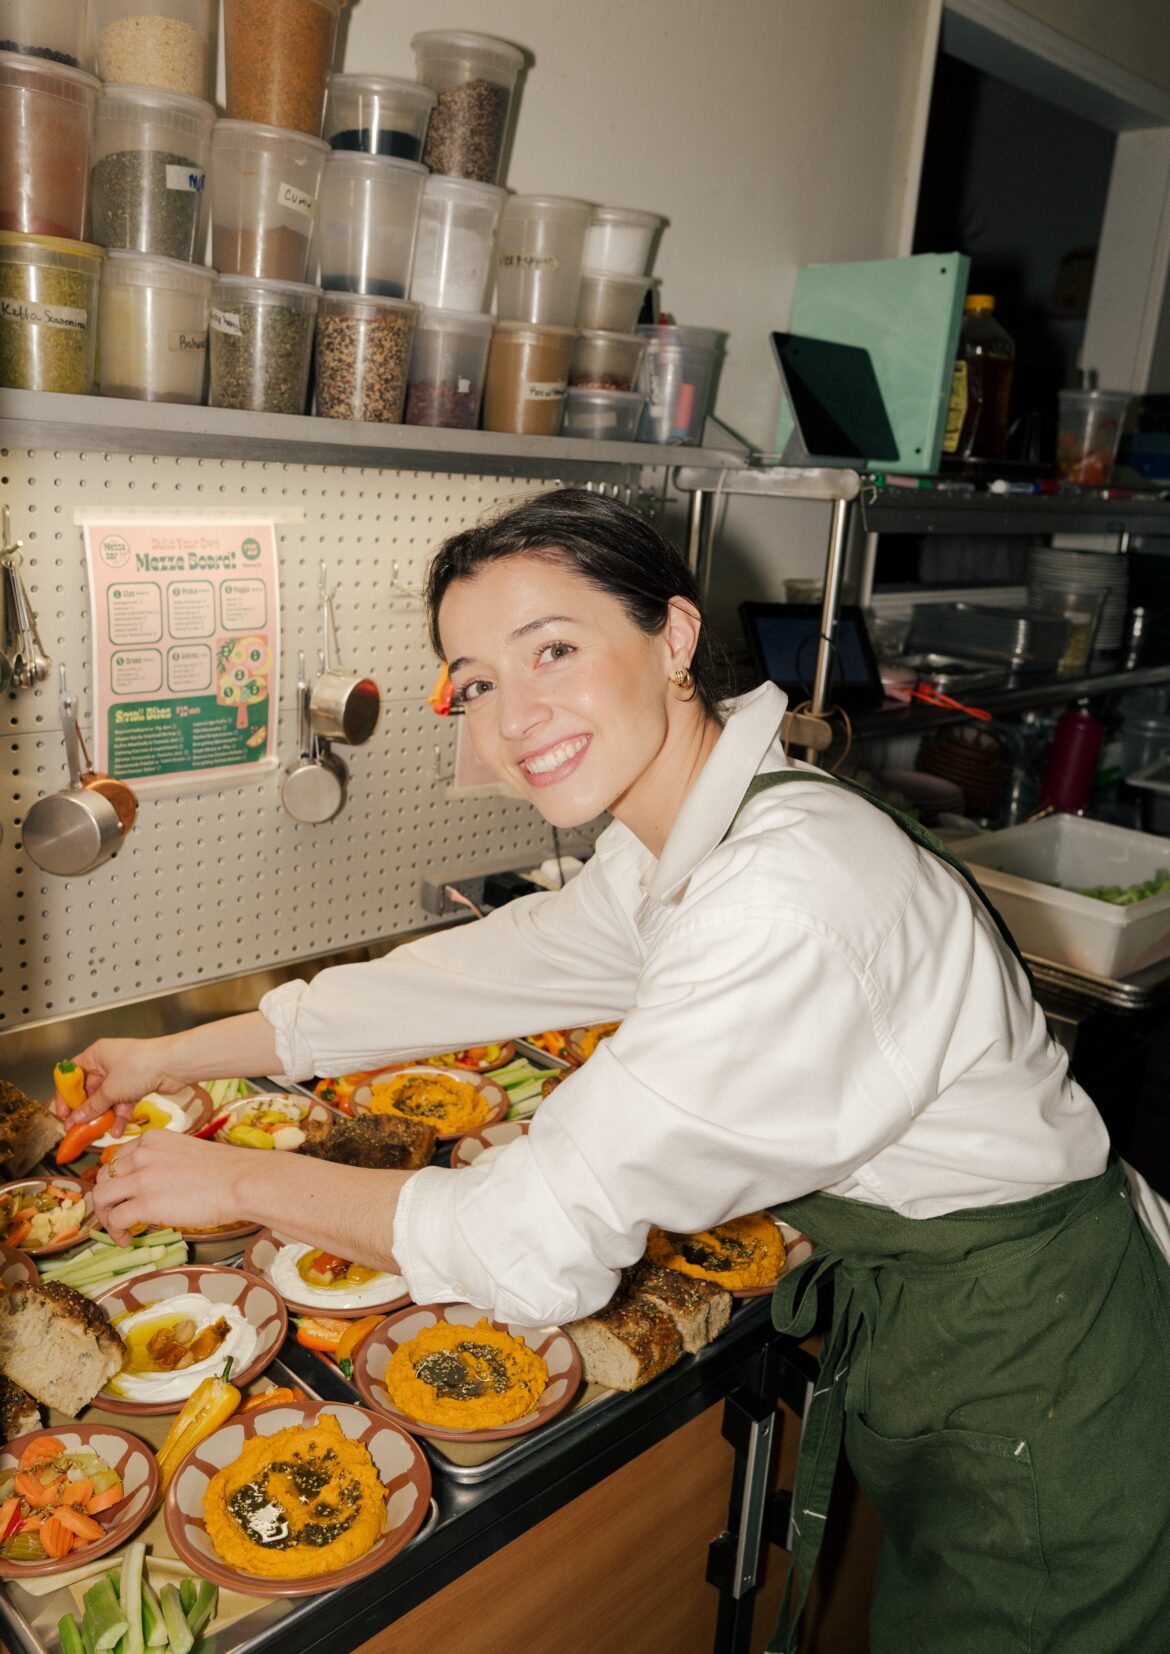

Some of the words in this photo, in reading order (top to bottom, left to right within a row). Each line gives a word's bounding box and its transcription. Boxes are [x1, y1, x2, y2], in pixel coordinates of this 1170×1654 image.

[135, 552, 185, 572] Mezze
[188, 551, 237, 571] Board!
[115, 709, 145, 724] Small
[146, 706, 172, 721] Bites
